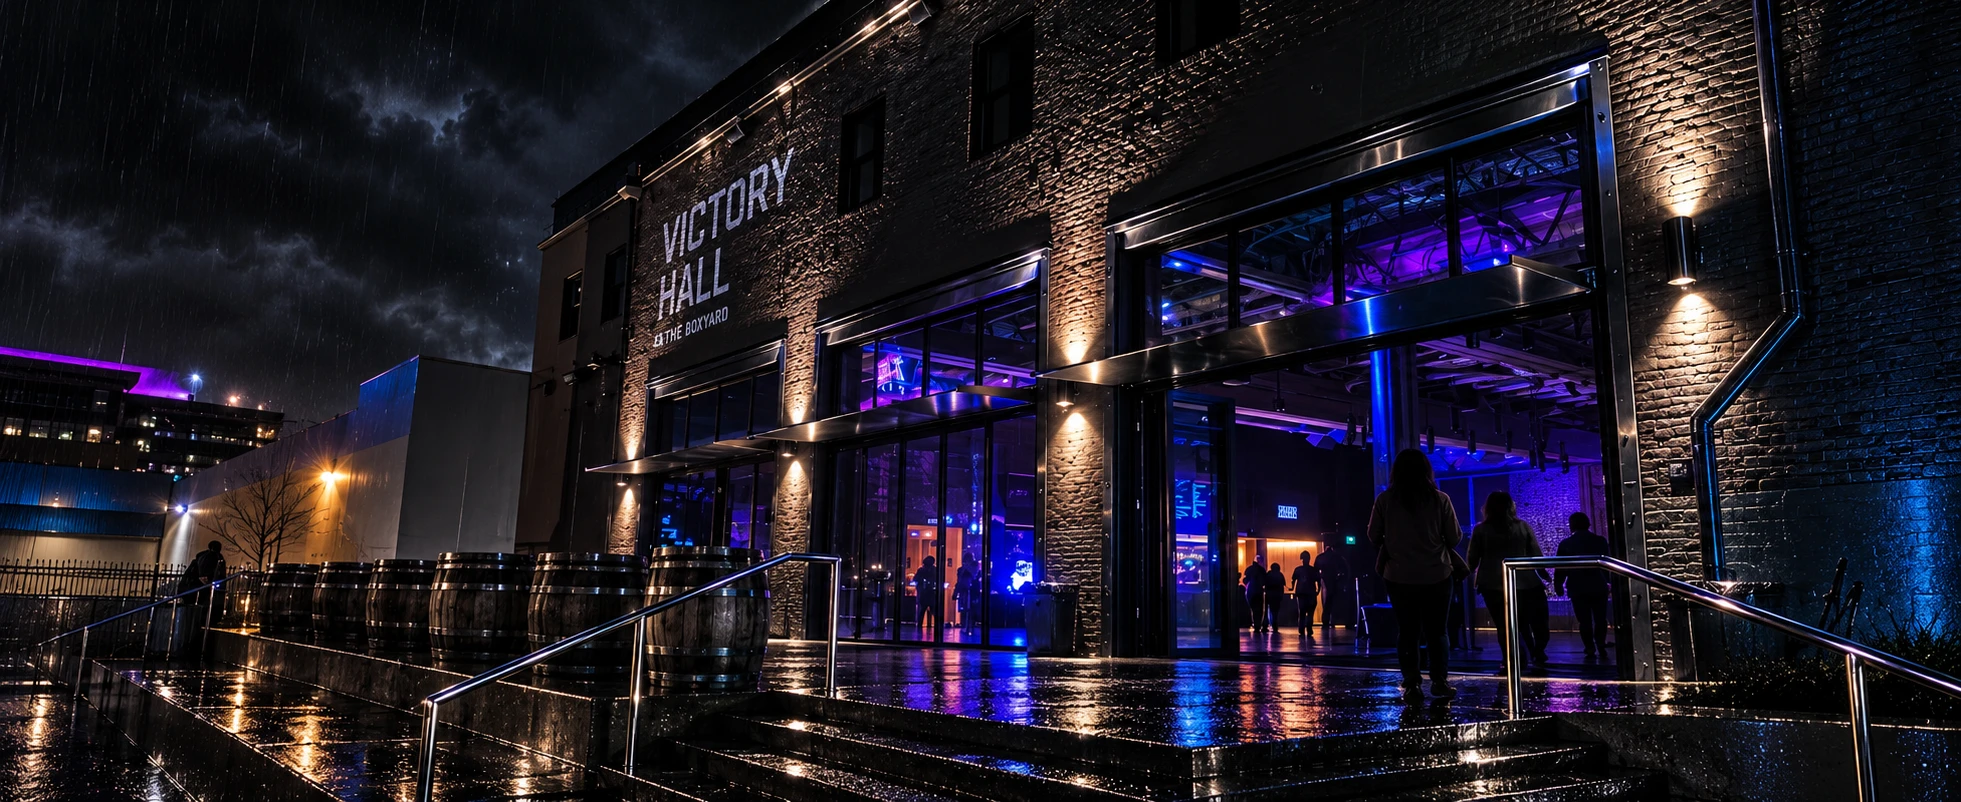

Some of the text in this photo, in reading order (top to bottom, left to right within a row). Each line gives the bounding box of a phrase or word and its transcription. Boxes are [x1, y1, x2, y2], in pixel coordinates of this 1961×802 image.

[664, 147, 794, 263] VICTORY
[657, 248, 729, 321] HALL
[685, 306, 729, 336] BOXYARD
